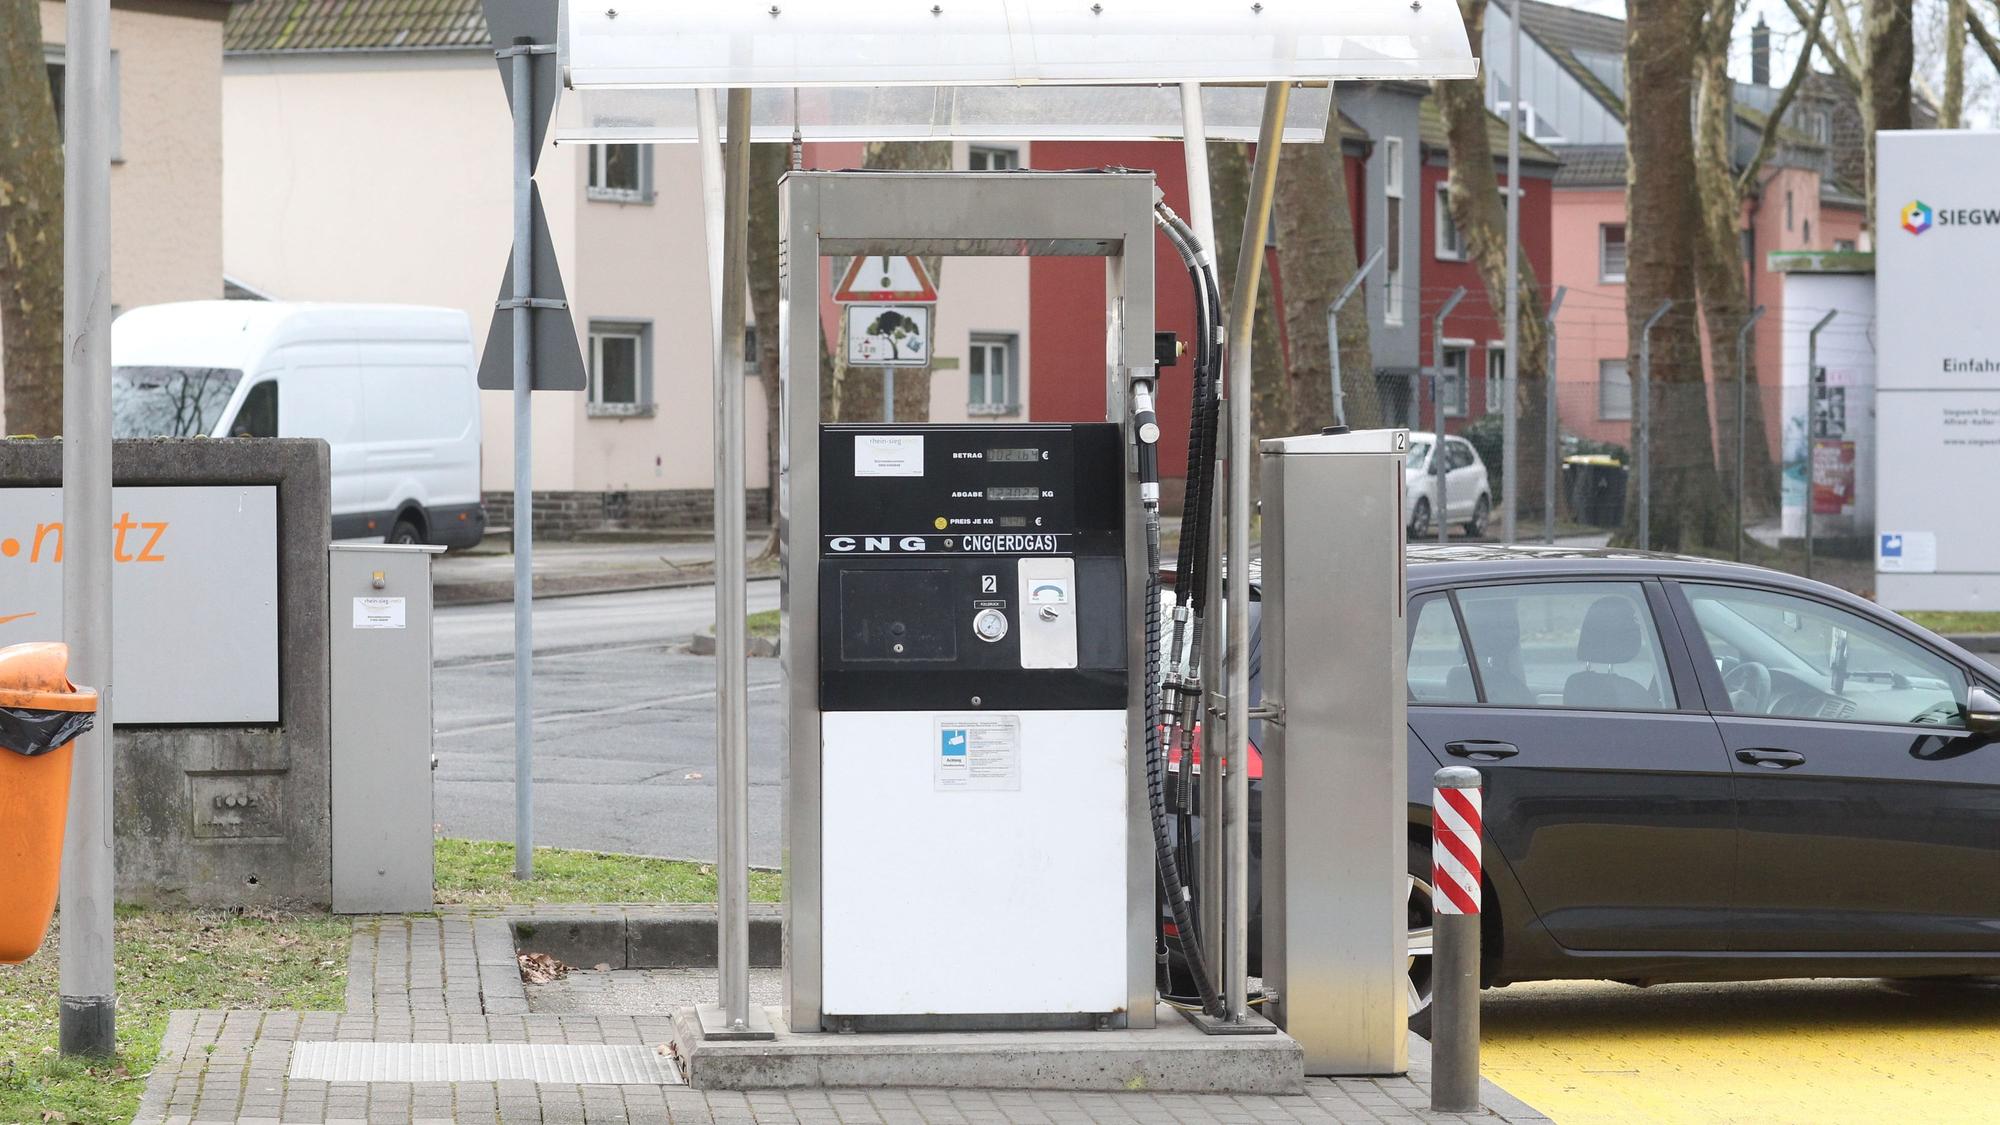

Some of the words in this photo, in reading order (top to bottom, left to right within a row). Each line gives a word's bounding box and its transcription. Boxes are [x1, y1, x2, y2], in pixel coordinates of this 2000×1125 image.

[1938, 209, 2000, 225] SIEGW
[1397, 433, 1404, 450] 2
[1041, 450, 1049, 460] €
[1042, 490, 1054, 498] KG
[1034, 516, 1042, 526] €
[30, 512, 169, 563] ntz
[962, 535, 1058, 554] CNG(ERDGAS)
[984, 576, 995, 592] 2
